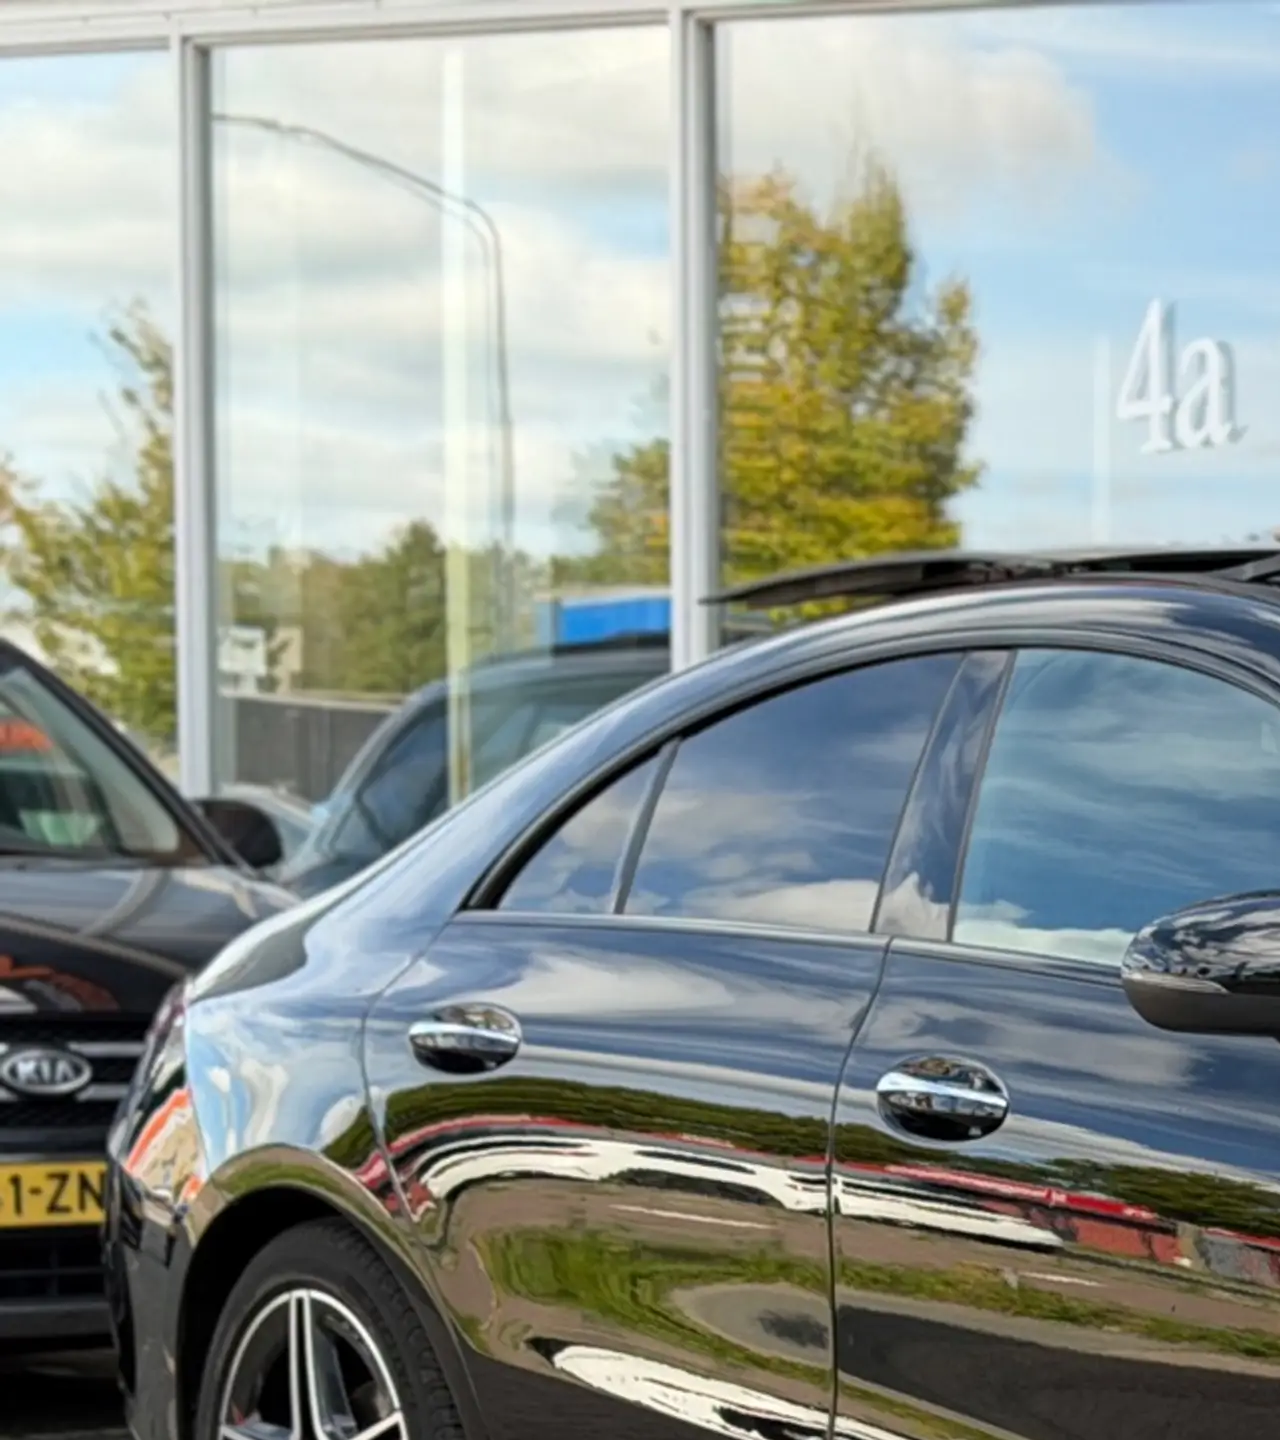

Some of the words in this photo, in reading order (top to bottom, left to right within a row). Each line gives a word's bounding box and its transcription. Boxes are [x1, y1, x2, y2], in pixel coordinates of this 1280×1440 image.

[1116, 298, 1238, 454] 4a
[17, 1059, 75, 1086] KIA
[0, 1170, 104, 1216] 1-ZN
